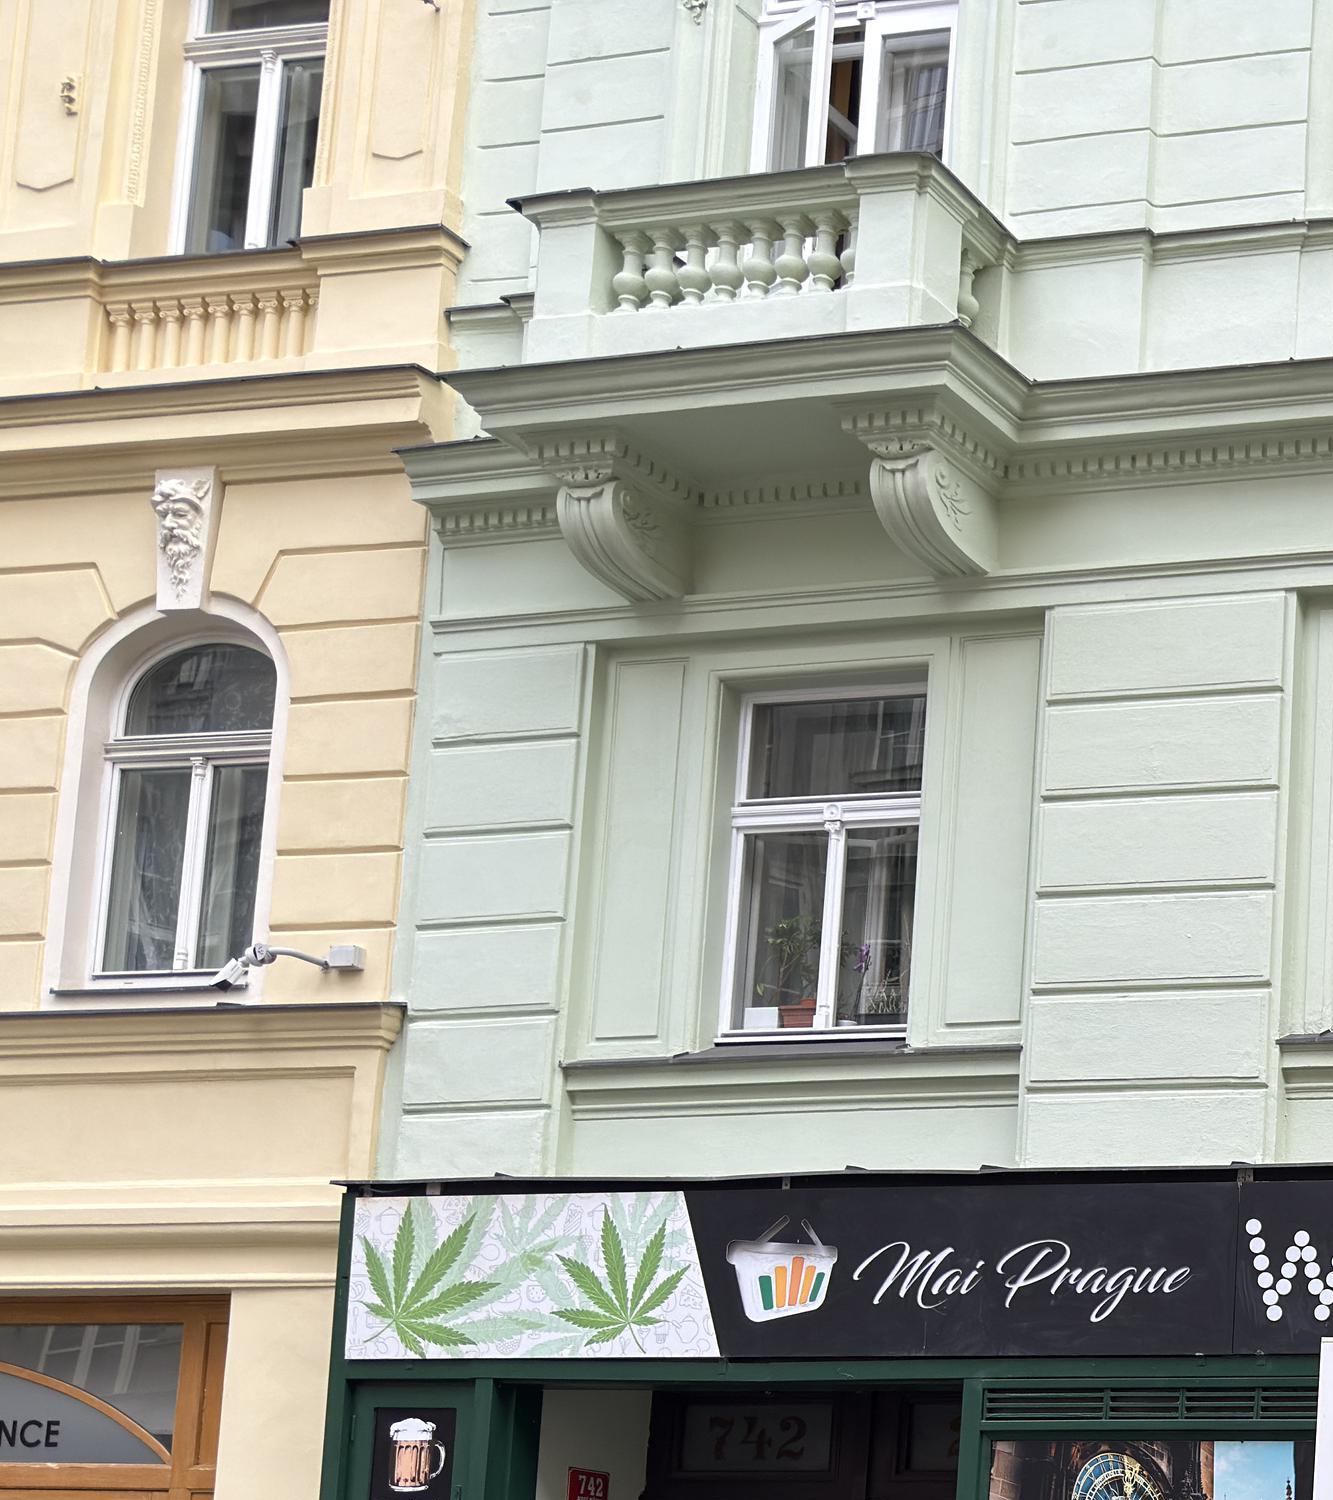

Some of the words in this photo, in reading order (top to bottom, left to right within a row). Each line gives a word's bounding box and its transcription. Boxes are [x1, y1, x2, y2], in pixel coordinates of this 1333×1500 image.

[853, 1241, 985, 1309] Mai
[995, 1239, 1193, 1322] Prague
[709, 1416, 807, 1460] 742
[578, 1475, 603, 1497] 742
